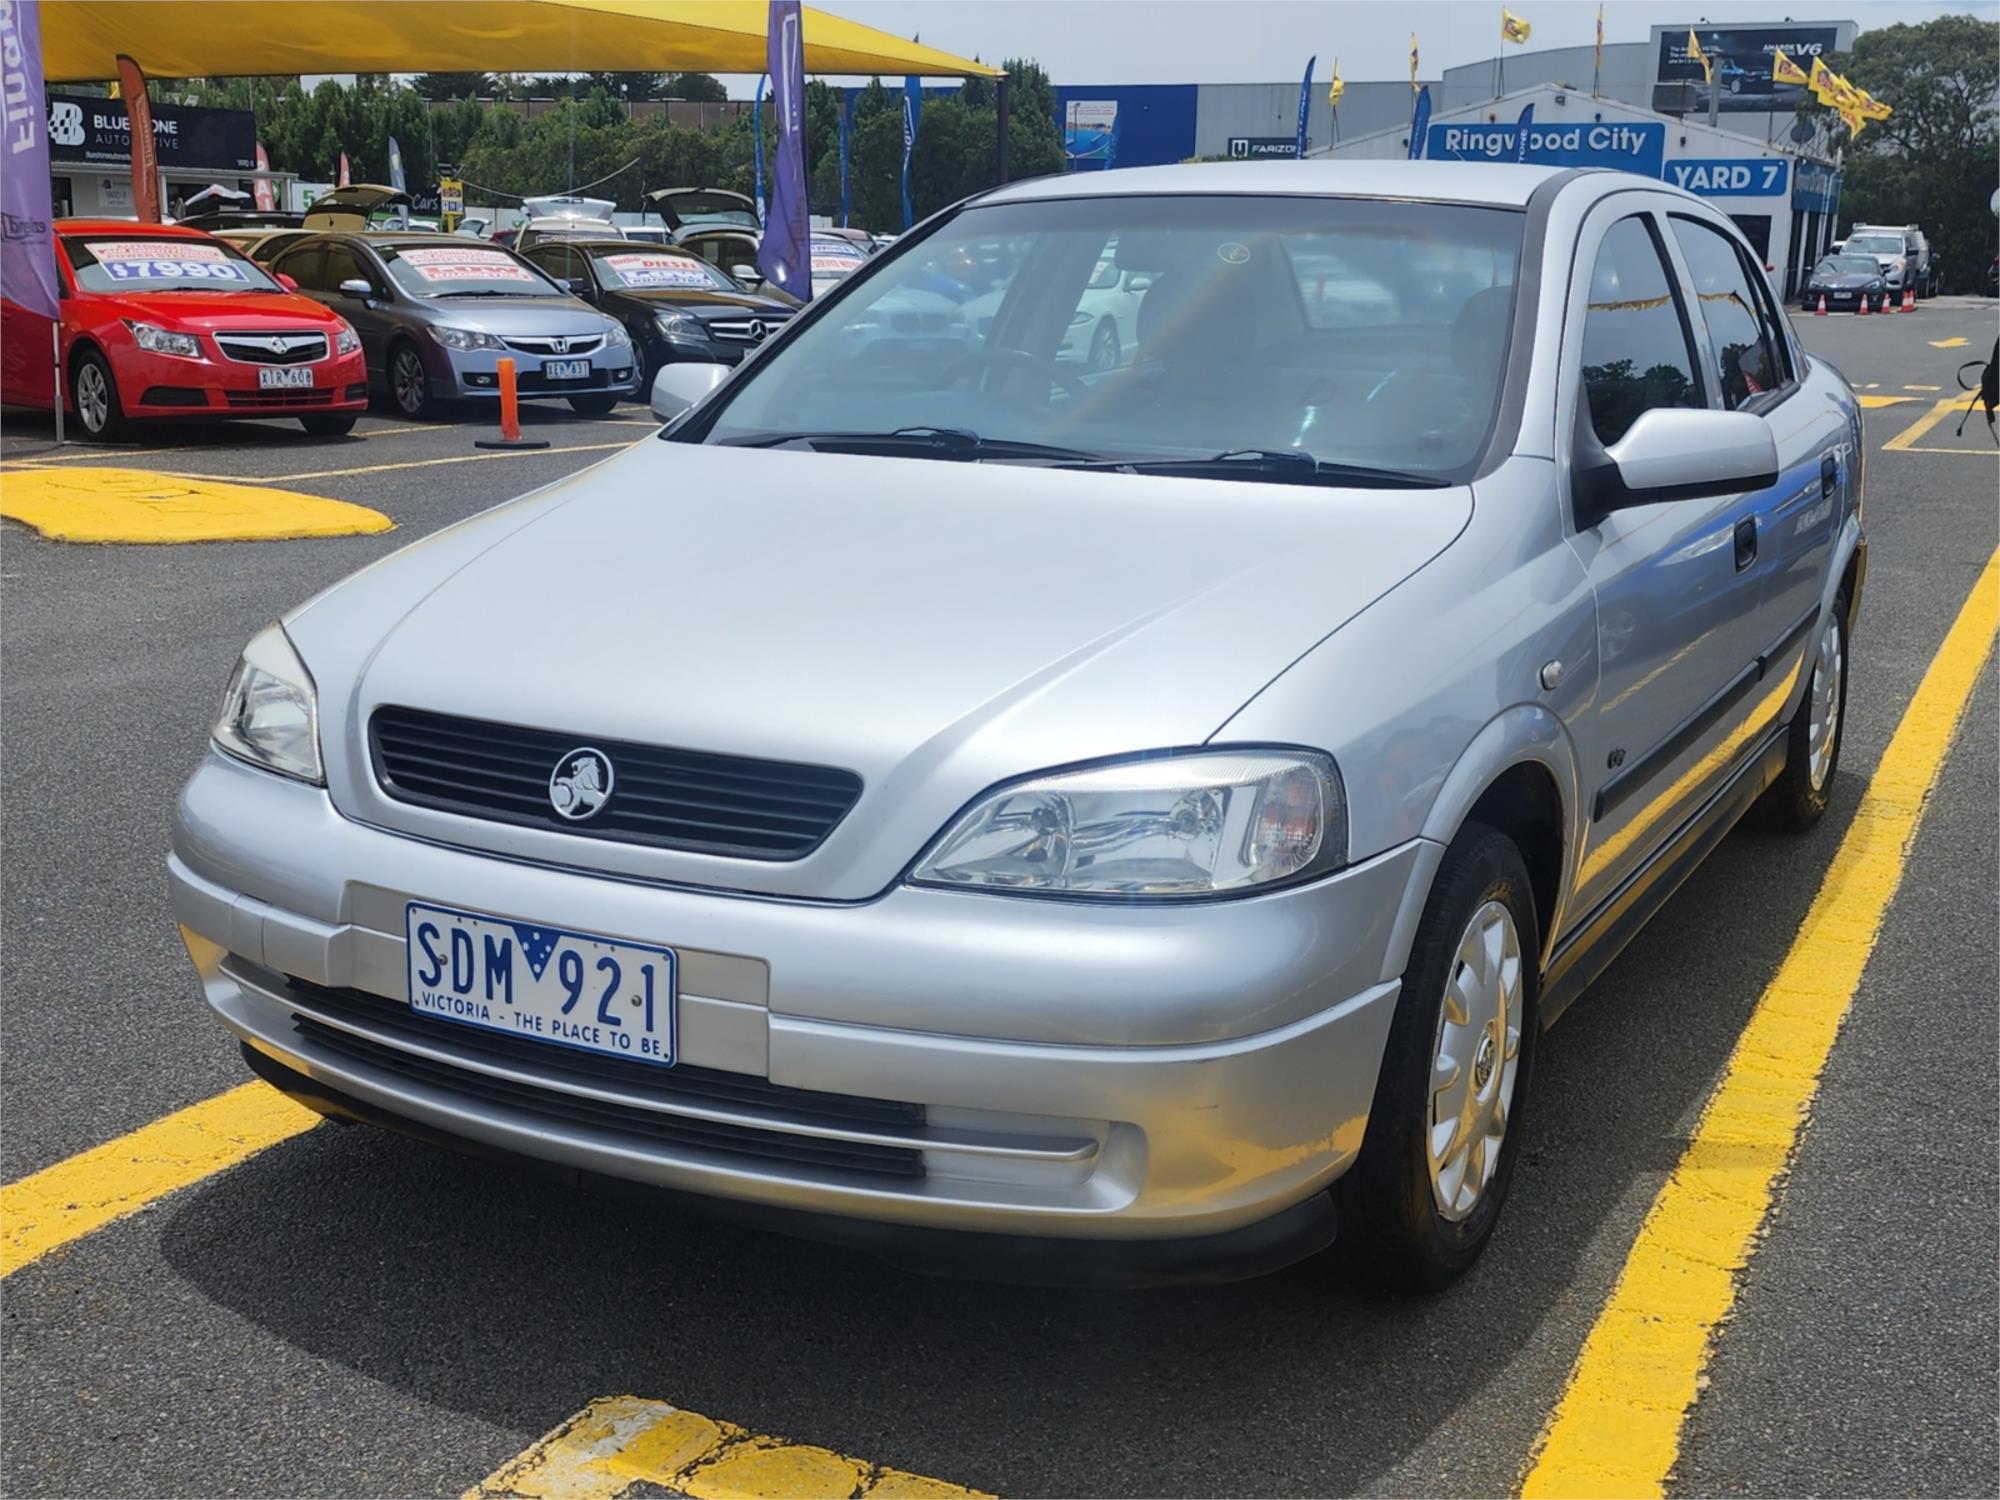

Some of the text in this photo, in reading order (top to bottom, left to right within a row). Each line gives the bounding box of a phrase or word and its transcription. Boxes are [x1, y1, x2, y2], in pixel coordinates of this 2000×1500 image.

[1796, 43, 1822, 56] V6
[93, 114, 178, 134] BLUEONE
[95, 133, 179, 149] AUTOTIVE
[1588, 127, 1647, 155] City
[1673, 166, 1779, 190] YARD 7
[112, 261, 238, 279] $7990
[416, 922, 656, 1033] SDM 921
[421, 990, 491, 1021] VICTORIA
[513, 1011, 544, 1033] THE
[551, 1019, 601, 1044] PLACE
[609, 1031, 632, 1050] TO
[640, 1037, 661, 1056] BE
